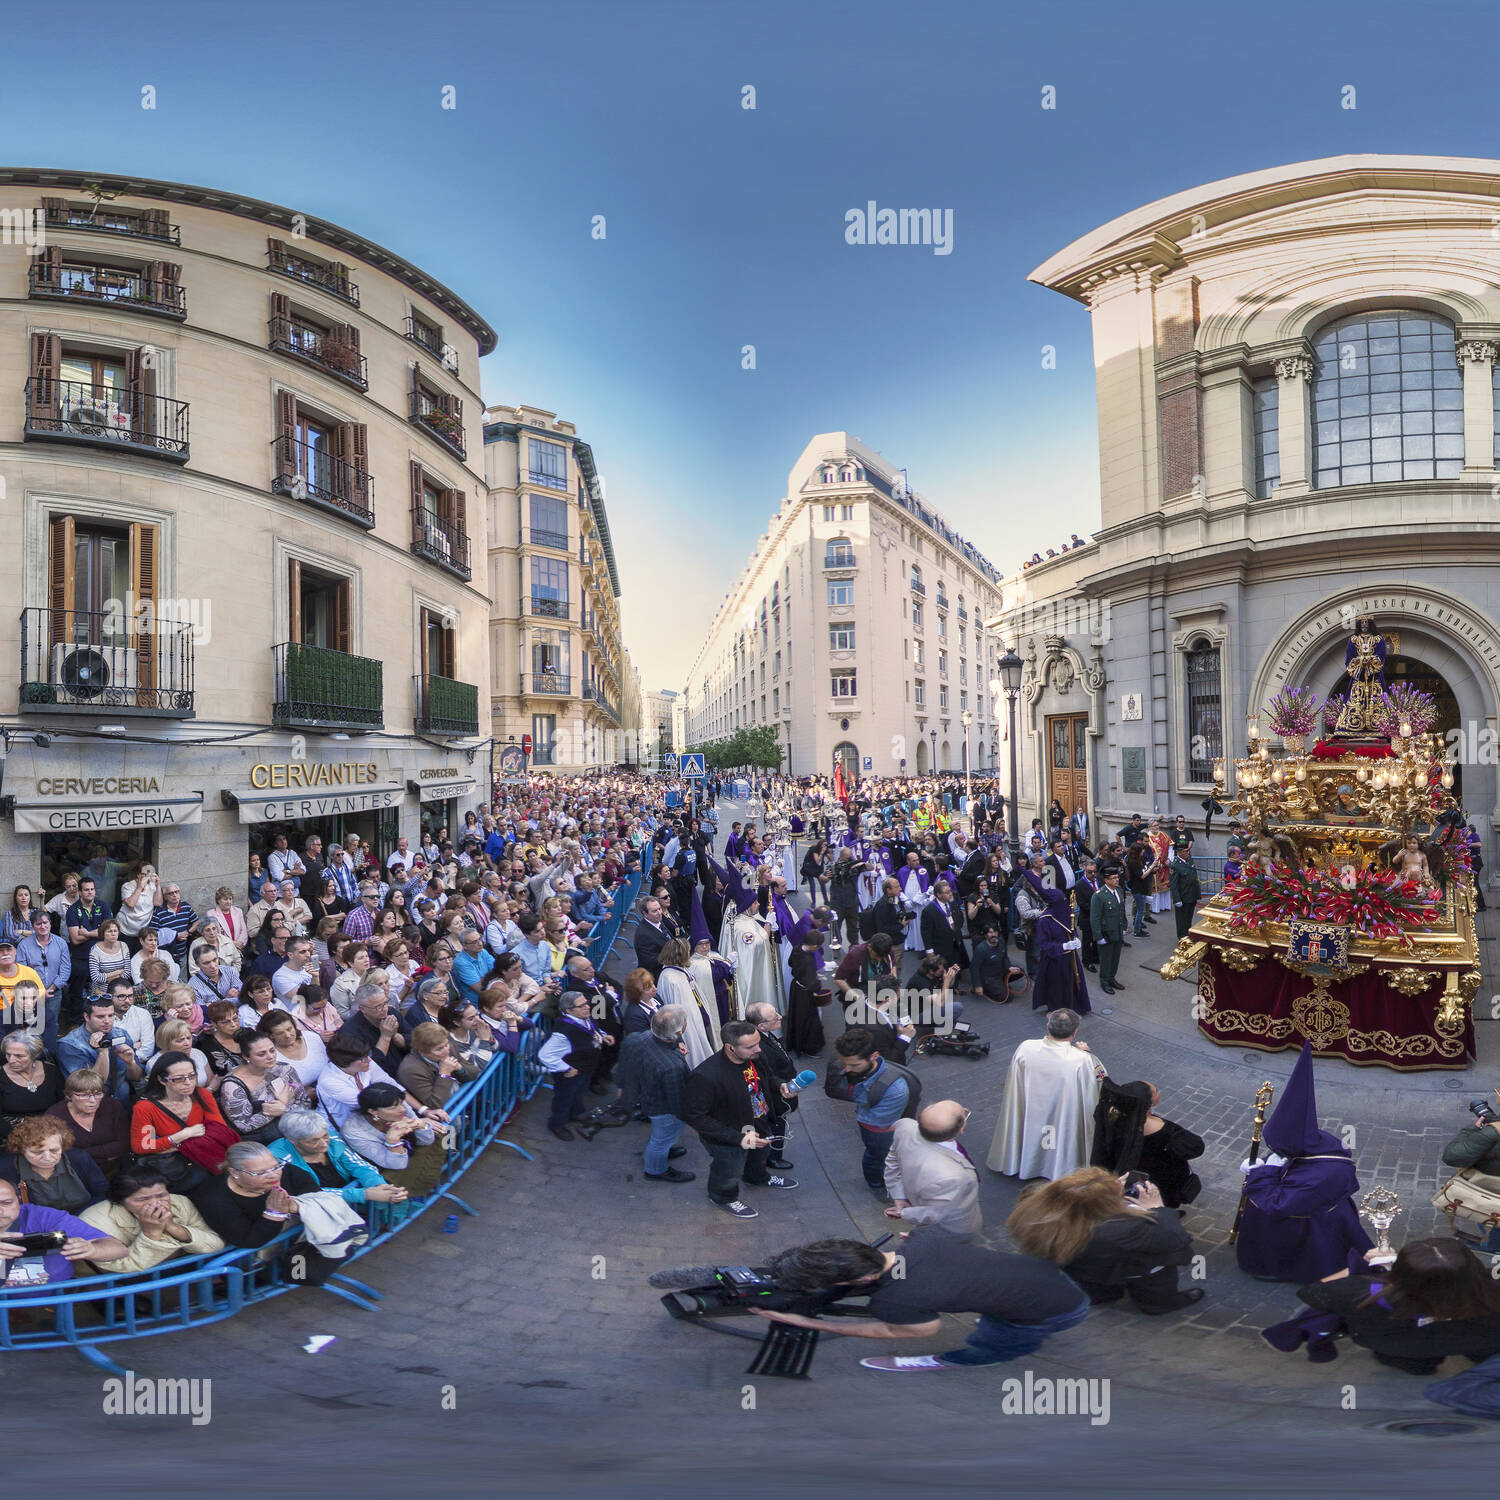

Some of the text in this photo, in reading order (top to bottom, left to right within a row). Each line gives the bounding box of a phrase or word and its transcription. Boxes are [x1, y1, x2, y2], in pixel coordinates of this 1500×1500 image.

[1275, 630, 1314, 680] BASILICA
[1316, 616, 1332, 630] DE
[1364, 598, 1406, 610] JESUS
[1414, 601, 1430, 613] DE
[251, 762, 380, 789] CERVANTES
[420, 768, 459, 780] CERVECERIA
[38, 777, 160, 795] CERVECERIA
[432, 785, 469, 799] CERVECERIA
[264, 793, 393, 820] CERVANTES
[49, 807, 175, 829] CERVECERIA
